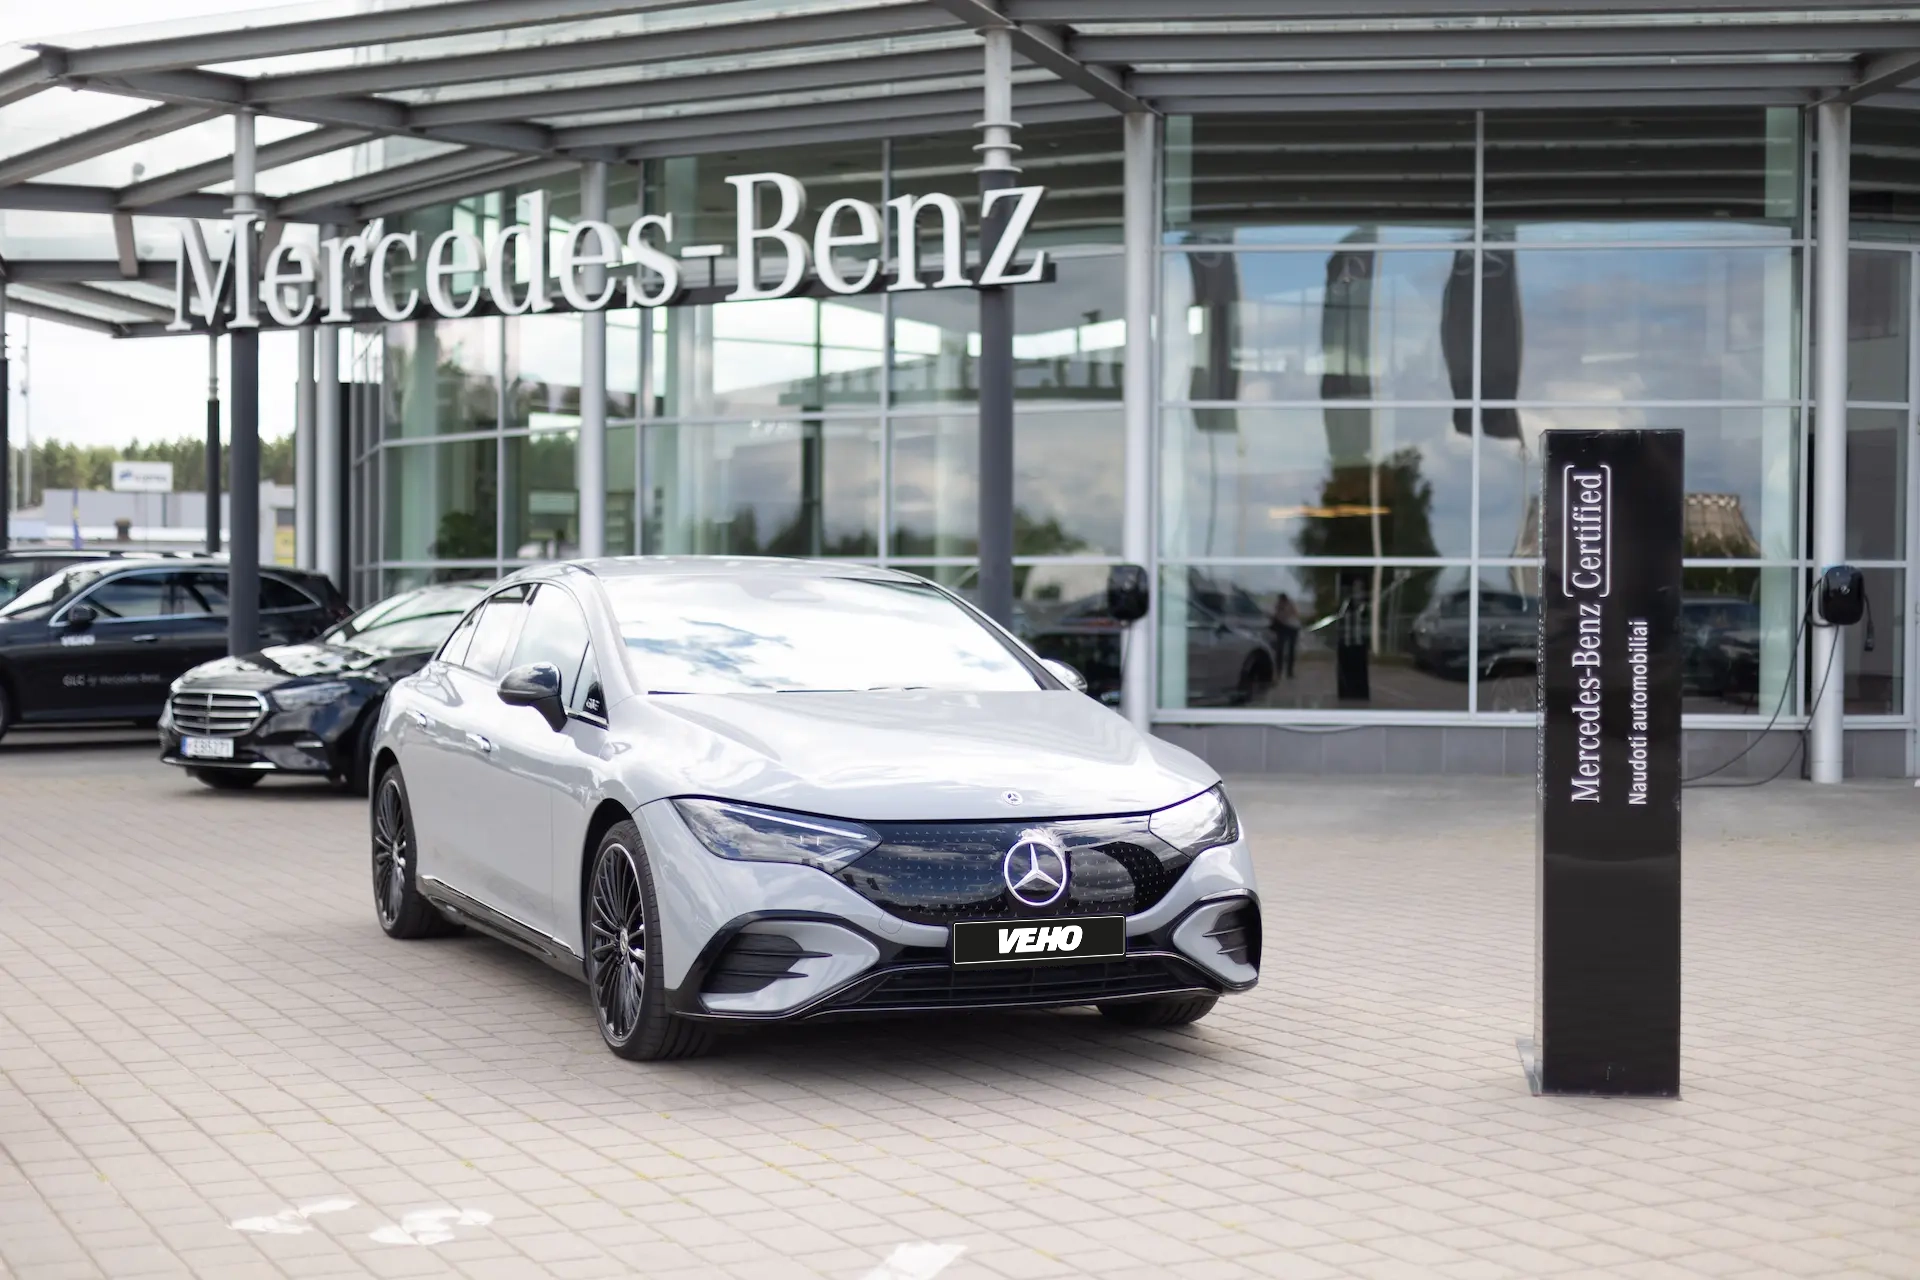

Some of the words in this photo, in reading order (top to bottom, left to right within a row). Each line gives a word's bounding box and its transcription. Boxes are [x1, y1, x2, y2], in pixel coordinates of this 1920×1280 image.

[166, 172, 1047, 331] Mercedes-Benz
[1572, 473, 1602, 589] Certified
[1571, 603, 1601, 803] Mercedes-Benz
[1628, 620, 1648, 731] automobiliai
[1628, 736, 1648, 805] Naudoti
[998, 925, 1083, 954] VEHO
